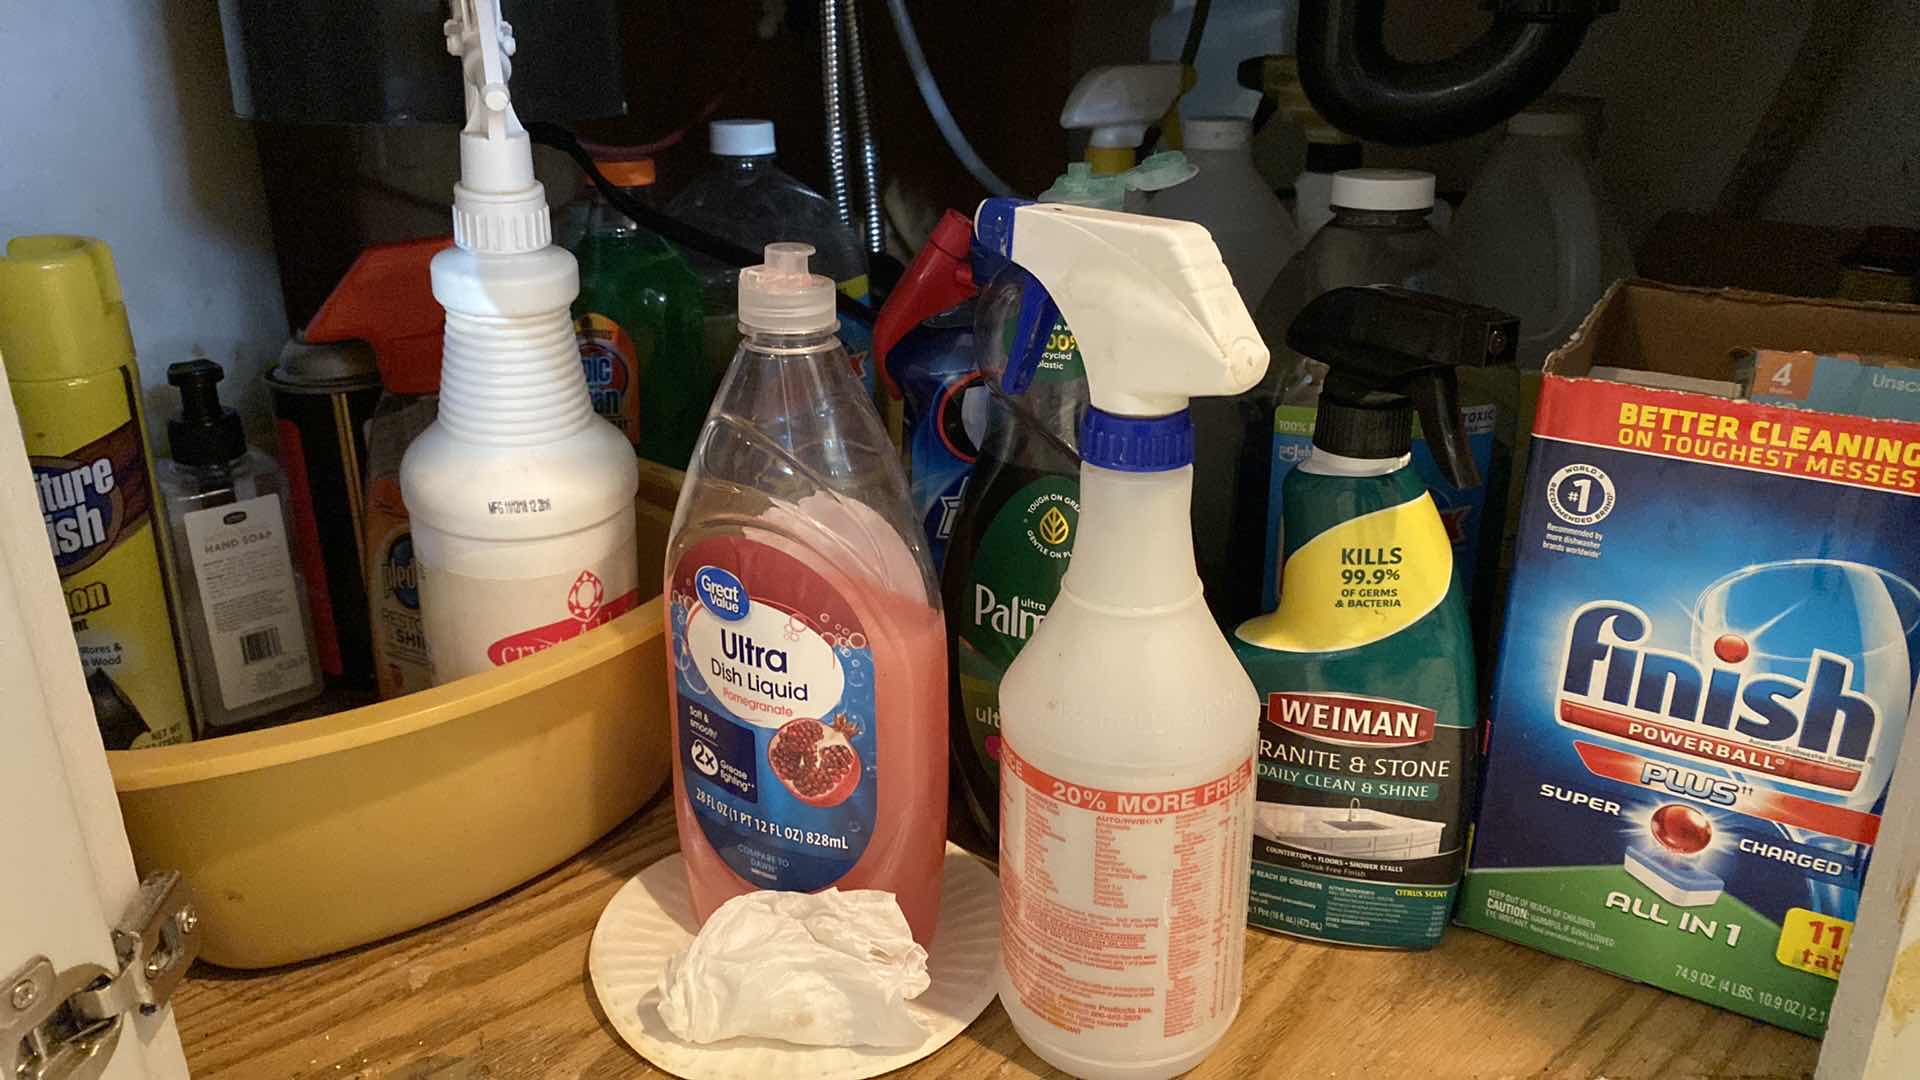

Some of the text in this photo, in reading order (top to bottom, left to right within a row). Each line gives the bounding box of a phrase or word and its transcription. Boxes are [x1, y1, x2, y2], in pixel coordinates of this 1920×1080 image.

[1772, 362, 1793, 387] 4
[1872, 373, 1920, 393] Unsc
[1618, 402, 1920, 468] BETTER CLEANING
[1618, 427, 1918, 488] ON TOUGHEST MESSES
[1027, 494, 1050, 514] TOUGH
[1050, 493, 1063, 502] ON
[204, 530, 273, 554] HAND SOAP
[1027, 529, 1049, 555] GENTLE
[1050, 550, 1062, 559] ON
[1340, 547, 1403, 566] KILLS
[700, 575, 740, 604] Great
[1340, 568, 1401, 585] 99.9%
[709, 594, 740, 614] Value
[1020, 598, 1046, 611] ultra
[1335, 598, 1402, 609] & BACTERIA
[1341, 588, 1398, 598] OF GERMS
[720, 627, 789, 674] Ultra
[711, 657, 809, 702] Dish Liquid
[1562, 604, 1876, 763] finish
[722, 686, 793, 718] Pomegranate
[1280, 698, 1419, 739] WEIMAN
[1258, 738, 1451, 779] RANITE & STONE
[1627, 721, 1776, 771] POWERBALL
[719, 759, 749, 780] Grease
[1257, 762, 1430, 799] DAILY CLEAN & SHINE
[1052, 763, 1251, 814] 20% MORE FREE
[1539, 783, 1623, 817] SUPER
[740, 812, 753, 827] PT
[755, 819, 767, 833] 12
[770, 825, 782, 838] FL
[784, 827, 804, 844] OZ)
[806, 832, 849, 850] 828mL
[777, 857, 790, 868] TO
[1265, 845, 1404, 873] COUNTERTOPS FLOORS SHOWER STALLS
[1738, 837, 1843, 878] CHARGED
[1394, 888, 1448, 899] CITRUS SCENT
[1487, 898, 1530, 920] CAUTION:
[1605, 890, 1742, 948] ALL IN 1
[1809, 920, 1845, 950] 11
[1802, 948, 1844, 973] tab
[1674, 964, 1699, 983] 74.9
[1718, 978, 1731, 994] (4
[1759, 991, 1782, 1010] 10.9
[1808, 1008, 1826, 1024] 2.1
